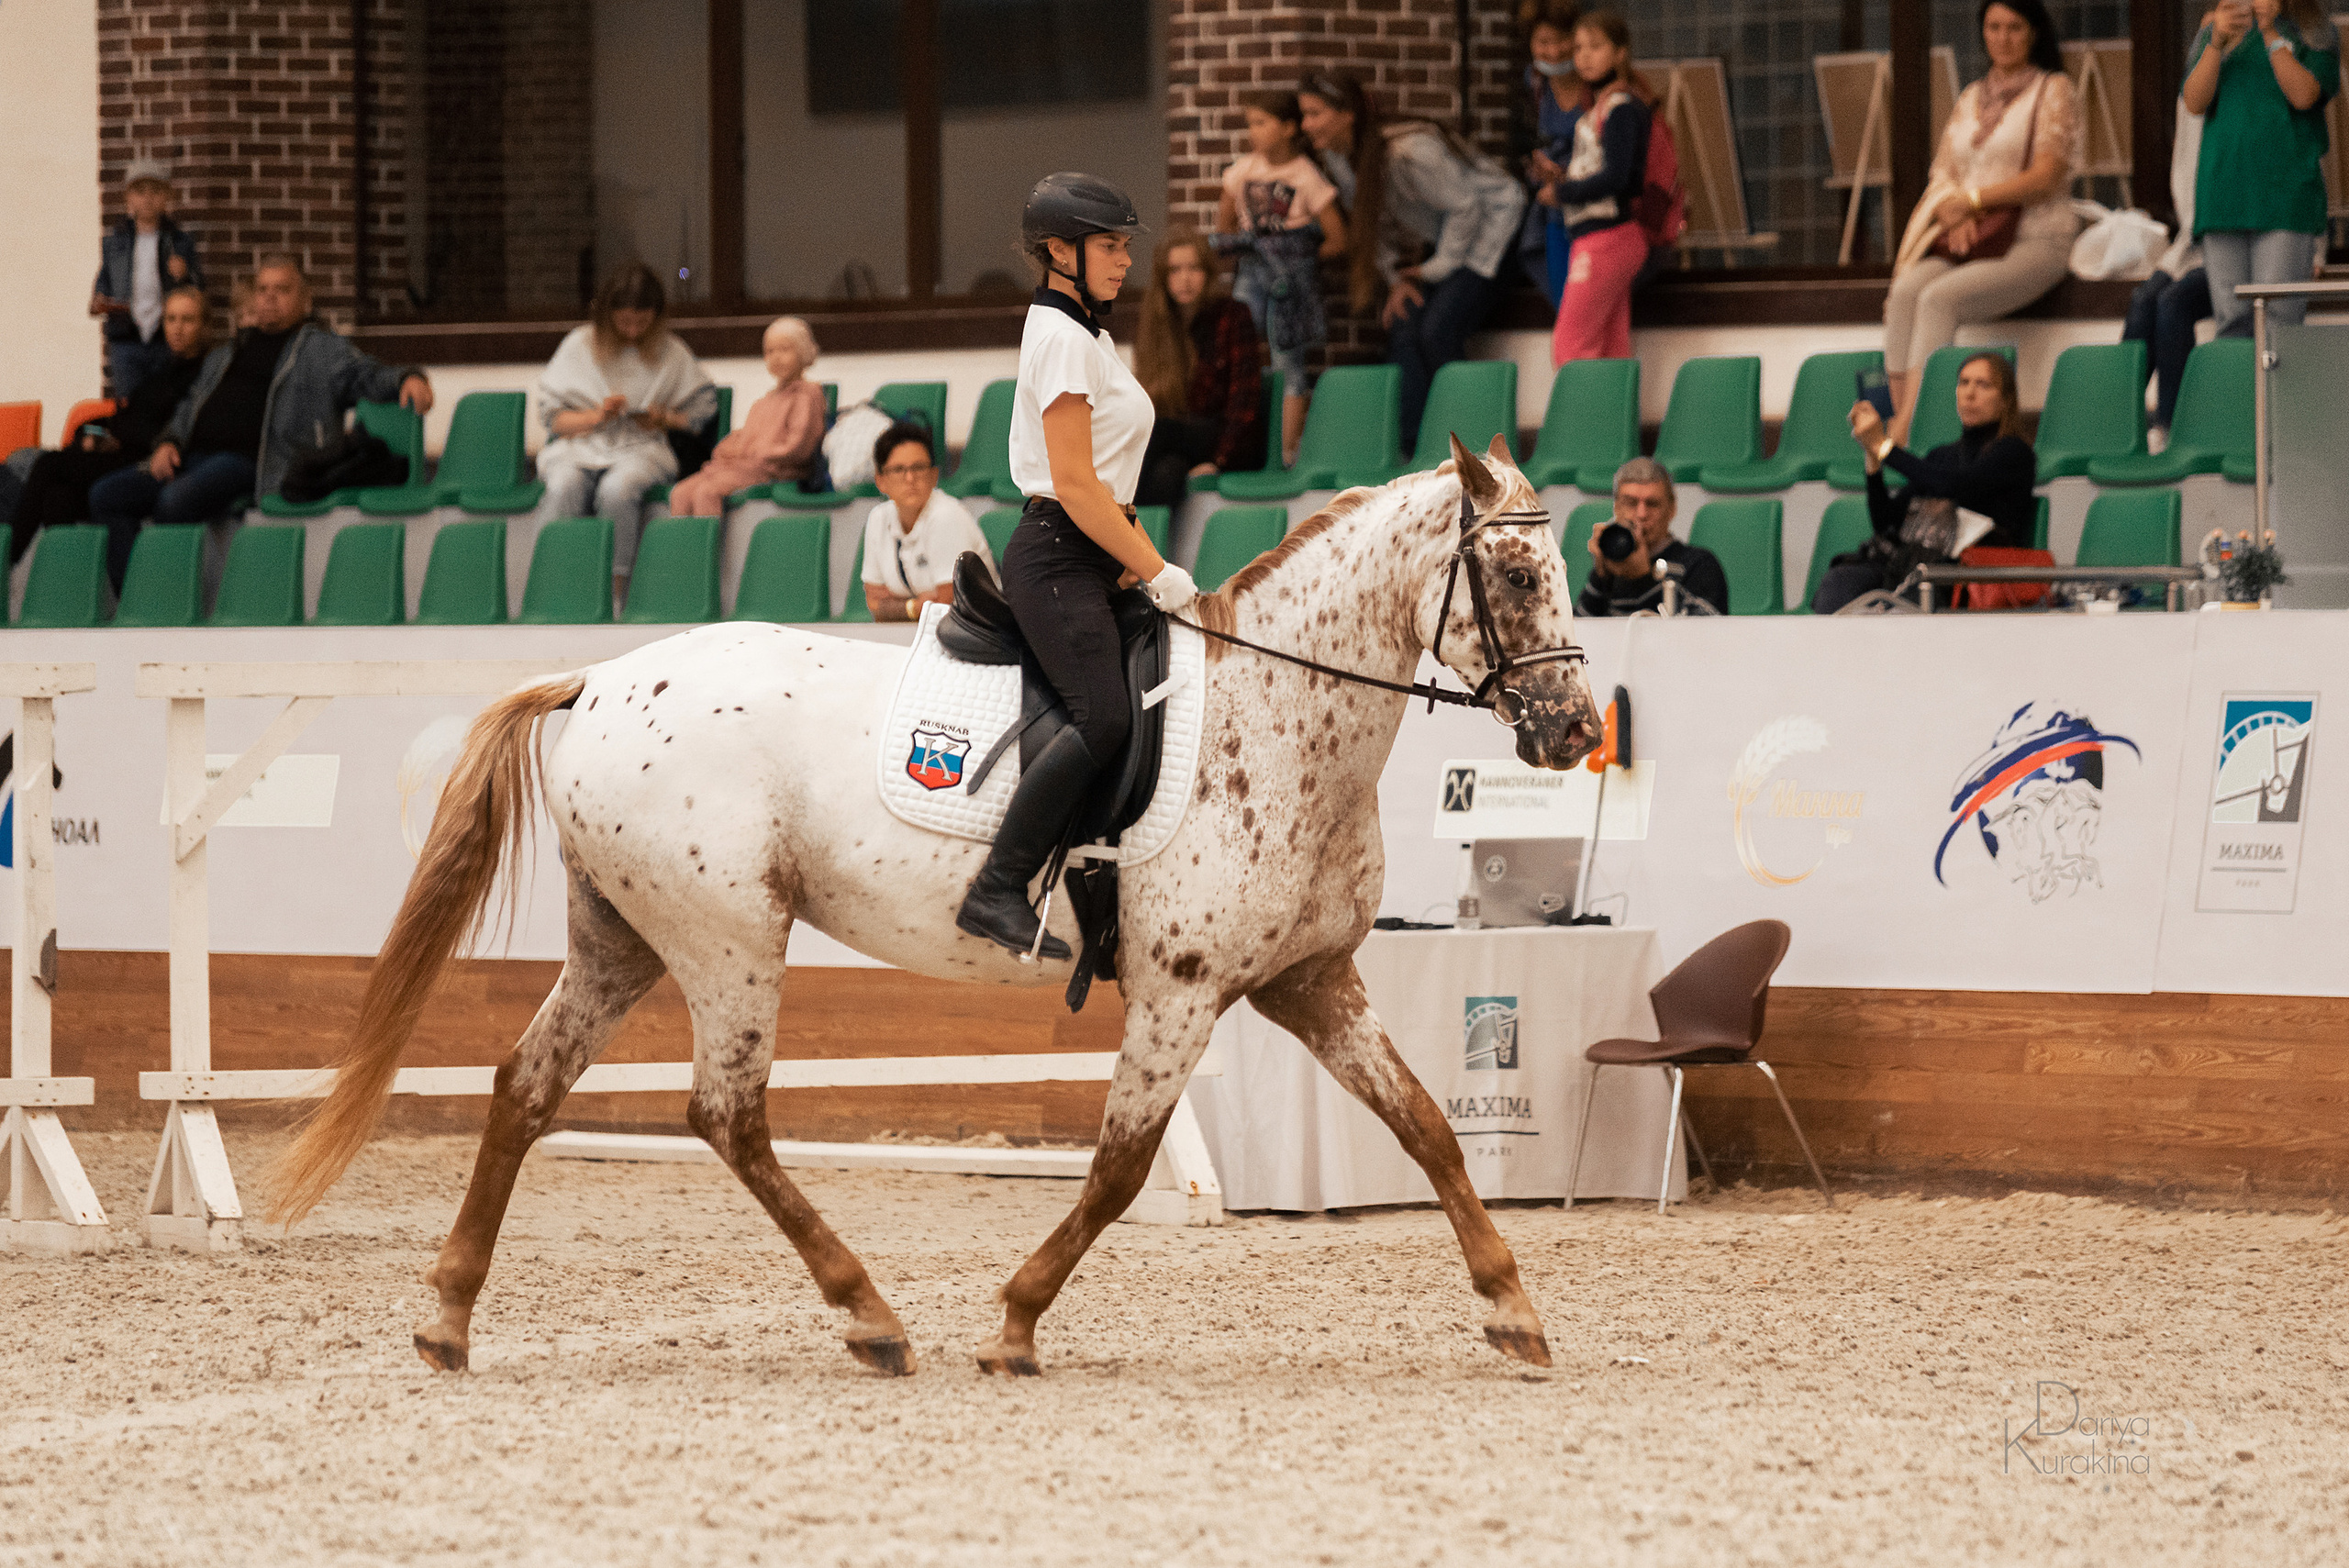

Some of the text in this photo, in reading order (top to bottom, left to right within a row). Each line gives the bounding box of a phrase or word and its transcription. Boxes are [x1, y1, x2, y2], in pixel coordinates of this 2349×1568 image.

[919, 719, 970, 736] RUSKNAB
[917, 737, 959, 782] K
[1767, 778, 1865, 819] Манна
[2218, 843, 2285, 861] MAXIMA
[1447, 1095, 1532, 1119] MAXIMA
